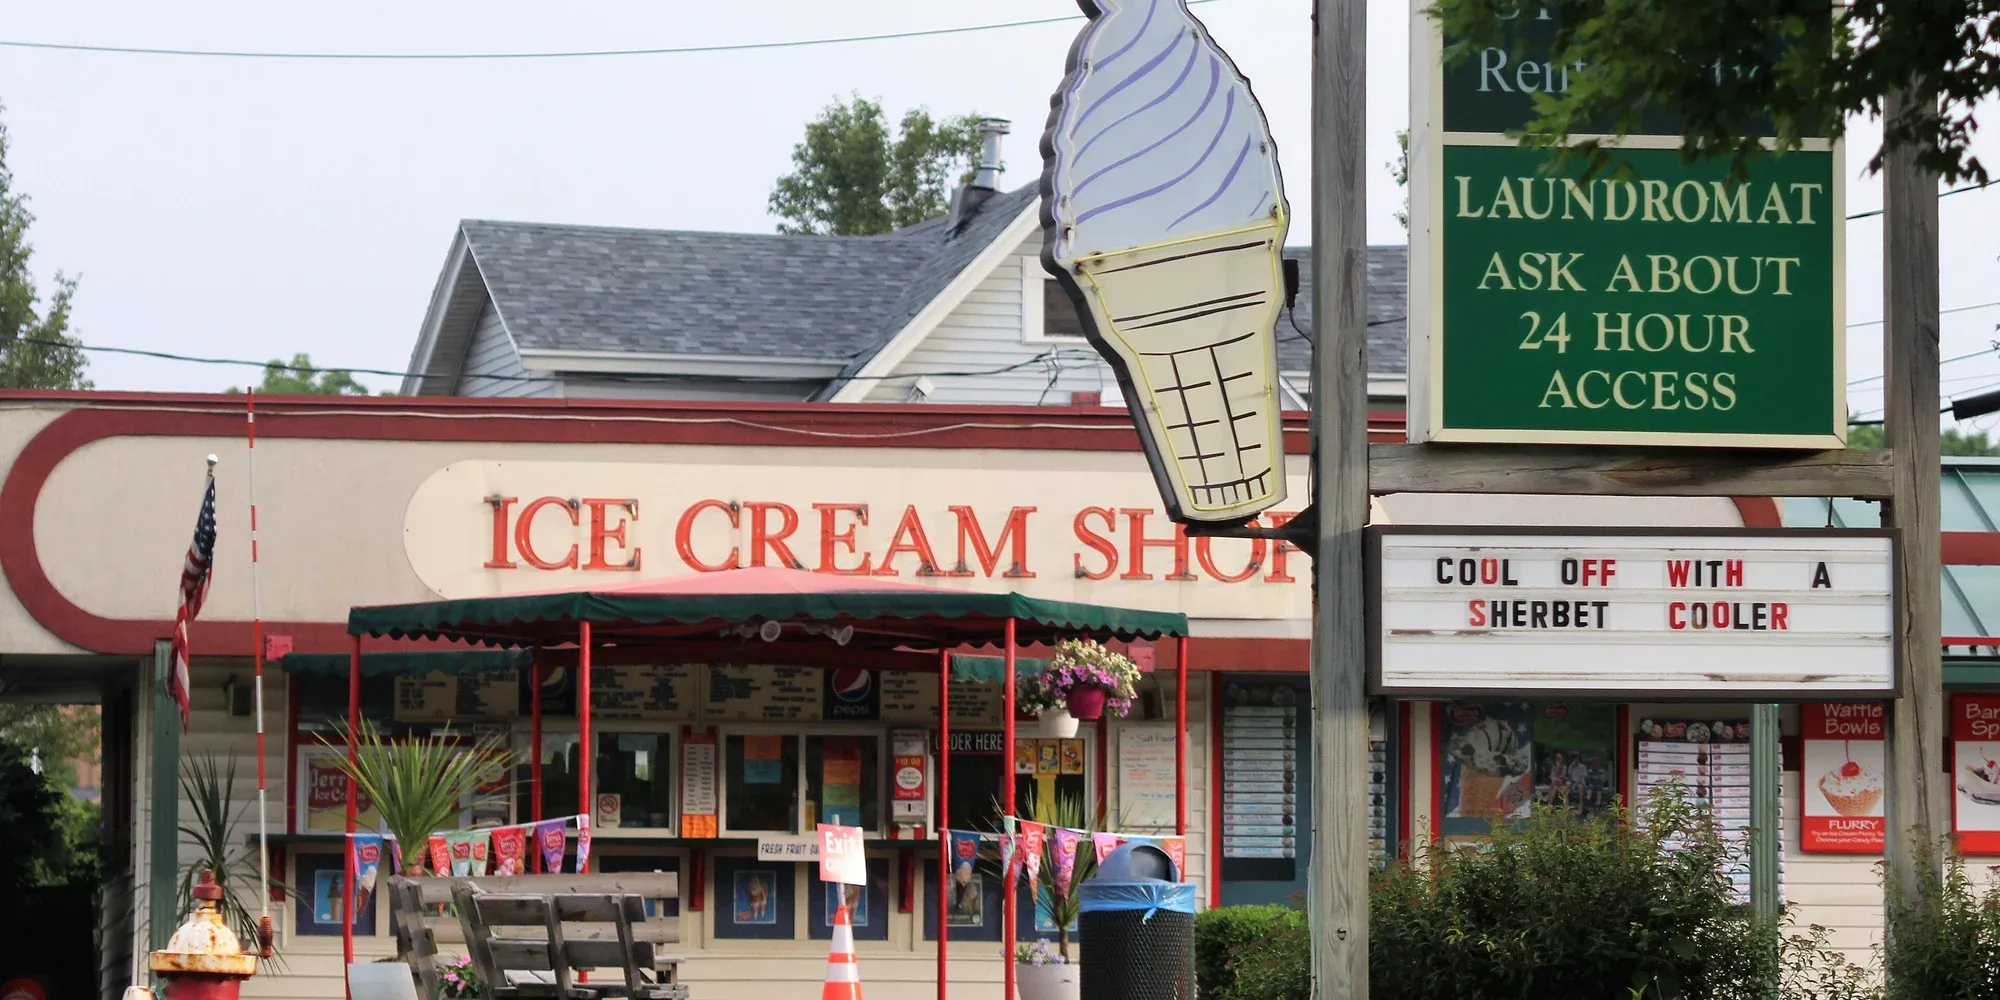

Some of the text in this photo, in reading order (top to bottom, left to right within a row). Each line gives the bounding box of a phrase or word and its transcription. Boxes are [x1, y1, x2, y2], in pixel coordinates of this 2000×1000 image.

[1455, 176, 1823, 225] LAUNDROMAT
[1476, 251, 1800, 296] ASK ABOUT
[1518, 311, 1755, 354] 24 HOUR
[1538, 370, 1737, 412] ACCESS
[483, 496, 641, 571] ICE
[675, 499, 1037, 578] CREAM
[1436, 556, 1831, 589] COOL OFF WITH A
[1468, 600, 1788, 630] SHERBET COOLER
[833, 704, 869, 716] pepsi
[975, 733, 1003, 750] HERE
[1825, 719, 1880, 735] Bowls
[1971, 720, 2000, 740] Sp
[1828, 820, 1878, 830] FLURRY
[760, 843, 783, 855] FRESH
[785, 843, 807, 855] FRUIT
